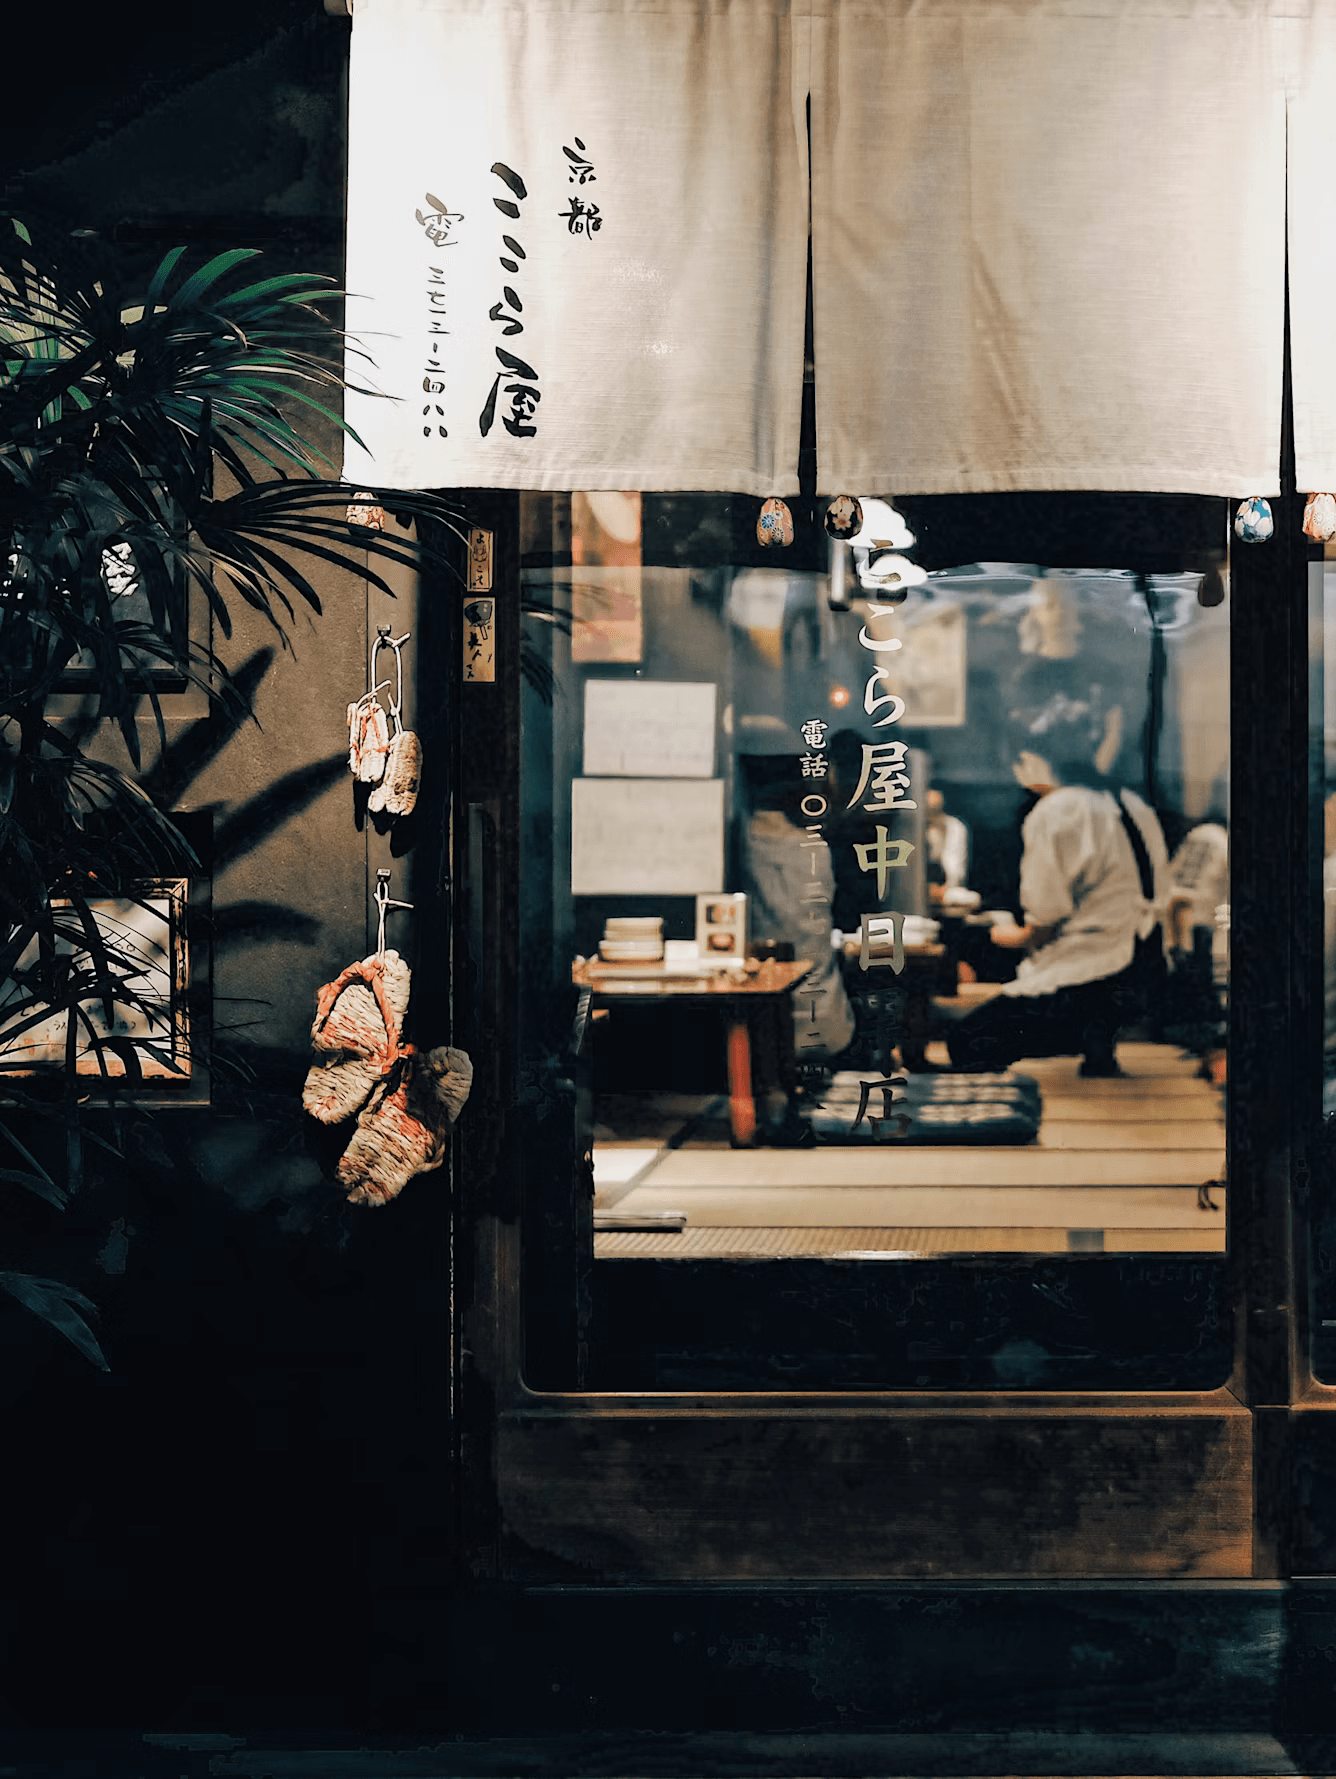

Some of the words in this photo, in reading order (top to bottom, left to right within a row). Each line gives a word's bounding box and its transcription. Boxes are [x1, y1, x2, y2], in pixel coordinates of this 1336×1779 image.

[558, 136, 603, 240] 京都
[479, 162, 540, 438] ここら屋
